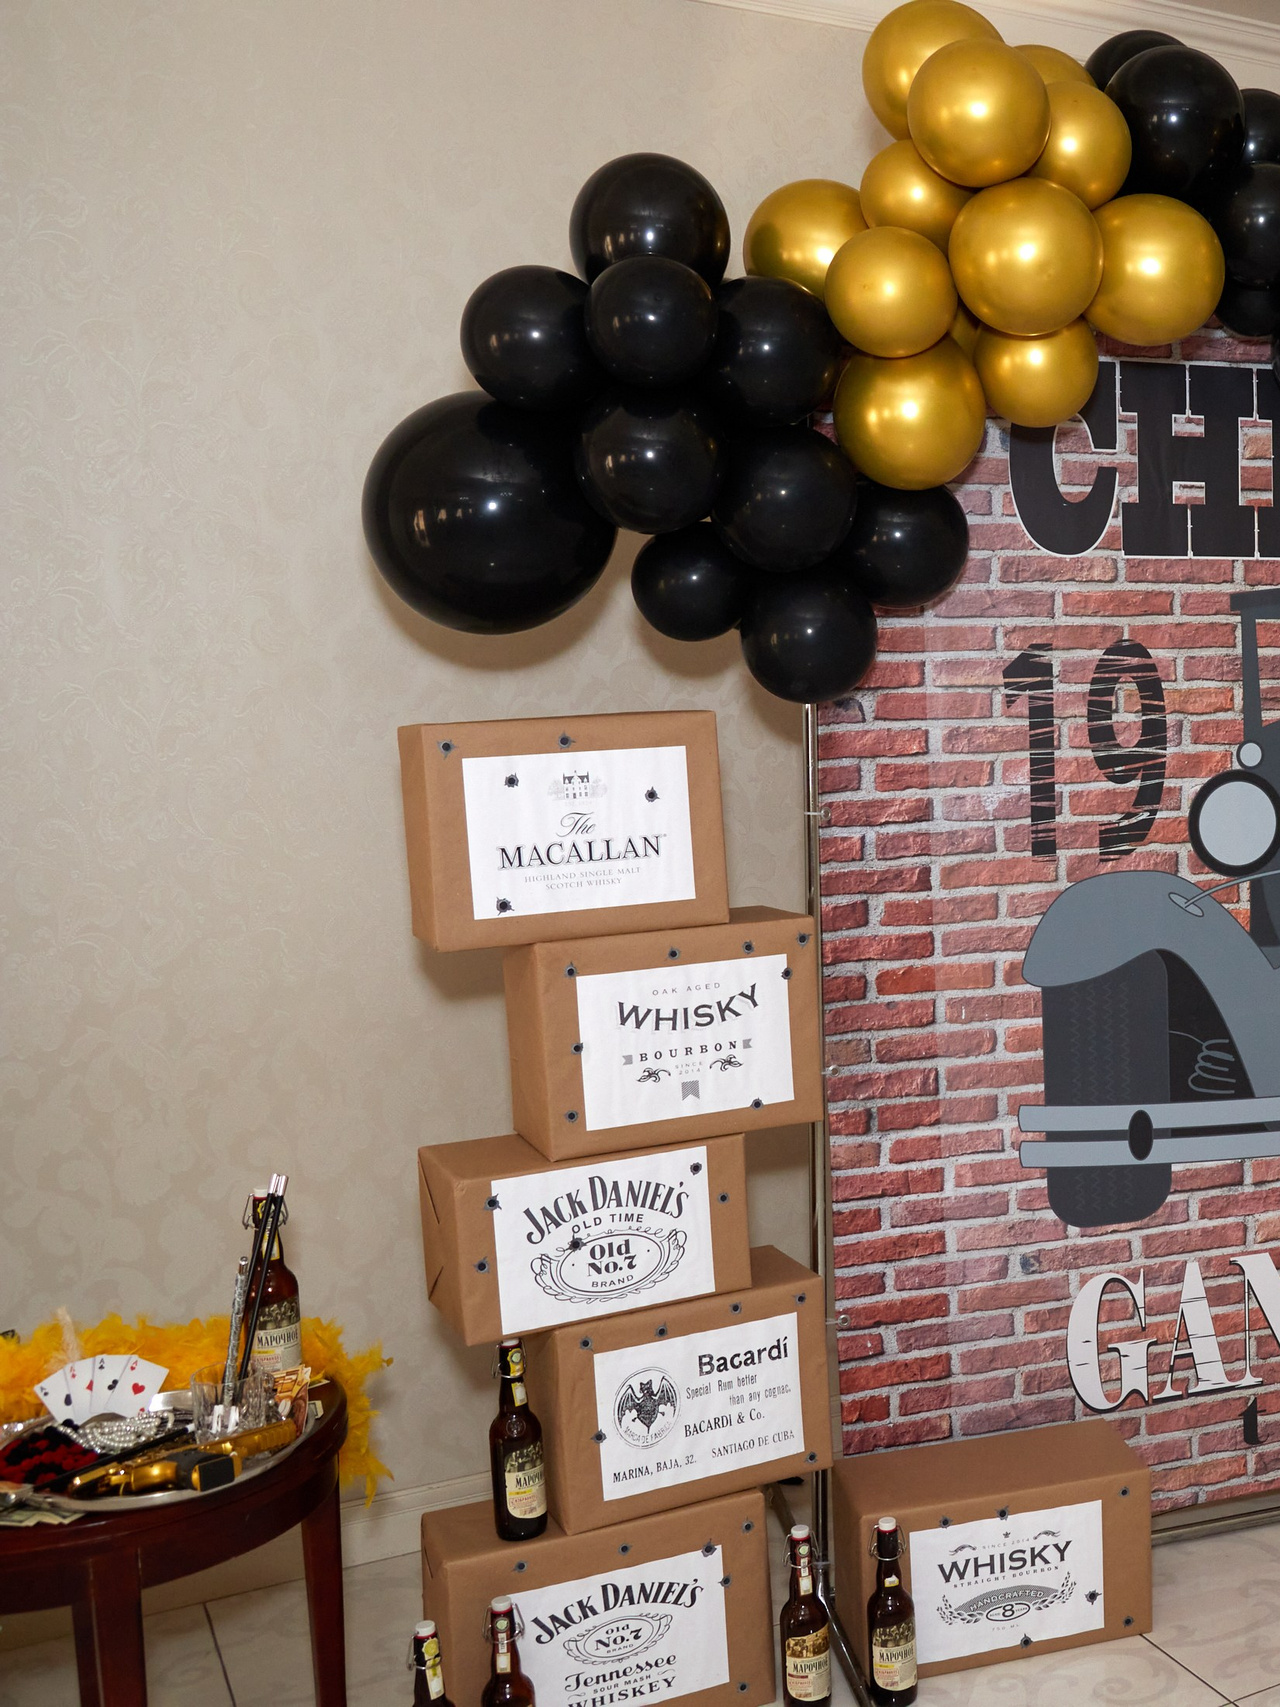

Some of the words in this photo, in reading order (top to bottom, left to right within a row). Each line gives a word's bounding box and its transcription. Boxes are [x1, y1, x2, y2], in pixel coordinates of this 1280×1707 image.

[1002, 639, 1168, 863] 19
[556, 812, 596, 838] The
[497, 834, 663, 870] MACALLAN
[524, 872, 577, 884] HIGHLAND
[579, 868, 614, 879] SINGLE
[617, 866, 642, 875] MALT
[545, 880, 584, 891] SCOTCH
[586, 877, 623, 888] WHISKY
[651, 987, 678, 997] OAK
[686, 981, 722, 993] AGED
[616, 982, 760, 1032] WHISKY
[639, 1040, 738, 1063] BOURBON
[674, 1061, 704, 1070] SINCE
[522, 1189, 589, 1245] JACK
[587, 1175, 690, 1219] DANIEL'S
[570, 1216, 603, 1235] OLD
[608, 1212, 645, 1224] TIME
[588, 1238, 632, 1262] Old
[590, 1274, 635, 1289] BRAND
[698, 1336, 789, 1377] Bacardí
[685, 1382, 712, 1400] Special
[717, 1379, 734, 1392] Rum
[736, 1373, 758, 1388] better
[729, 1392, 745, 1406] than
[748, 1387, 761, 1402] any
[684, 1413, 733, 1438] BACARDI
[736, 1411, 746, 1425] &
[749, 1408, 766, 1421] Co.
[612, 1466, 654, 1484] MARINA,
[684, 1454, 698, 1466] 32.
[711, 1437, 756, 1459] SANTIAGO
[757, 1434, 770, 1448] DE
[772, 1429, 795, 1444] CUBA
[937, 1540, 1073, 1584] WHISKY
[953, 1575, 1006, 1588] STRAIGHT
[1012, 1565, 1060, 1578] BOURBON
[530, 1595, 601, 1645] JACK
[600, 1578, 705, 1613] DANIEL'S
[969, 1589, 1045, 1612] HANDCRAFTED
[1002, 1603, 1015, 1617] 8
[605, 1623, 631, 1636] Old
[606, 1643, 635, 1654] BRAND
[564, 1654, 678, 1693] Tennessee
[592, 1683, 620, 1695] SOUR
[624, 1674, 652, 1686] MASH
